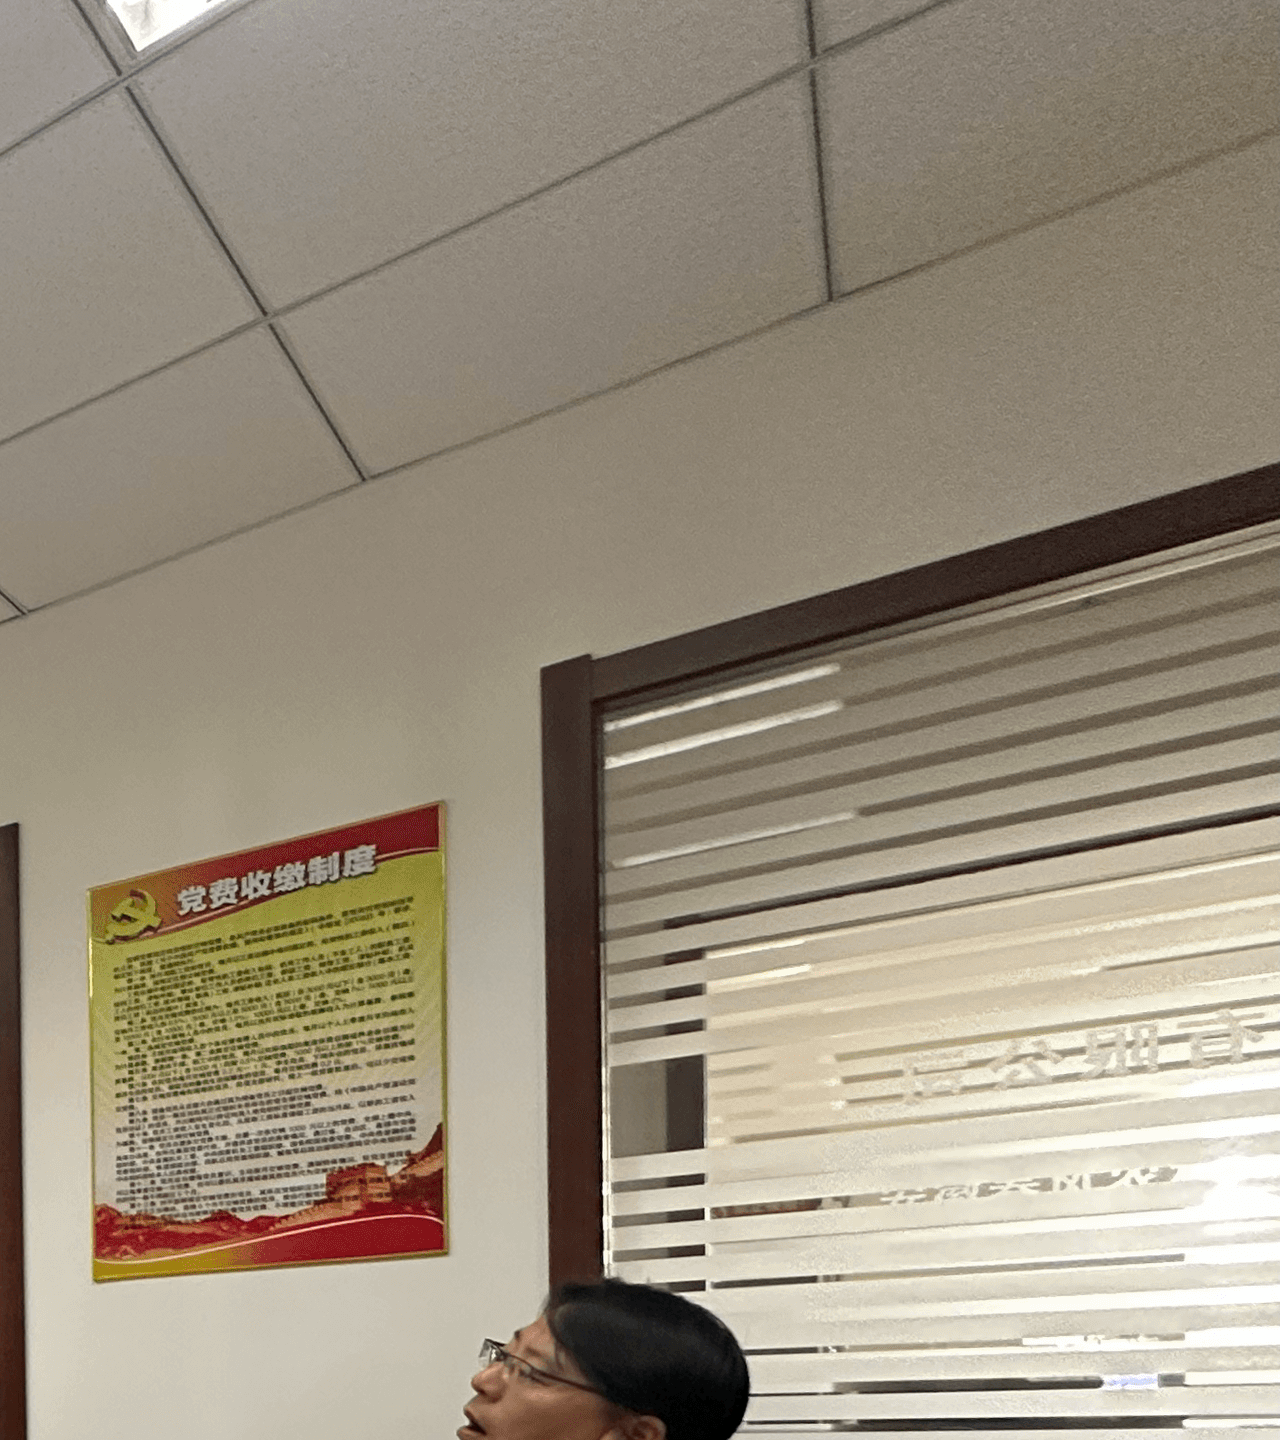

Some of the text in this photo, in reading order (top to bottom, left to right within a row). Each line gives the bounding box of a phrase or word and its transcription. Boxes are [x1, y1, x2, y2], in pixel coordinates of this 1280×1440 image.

[177, 844, 377, 916] 党费收缴制度
